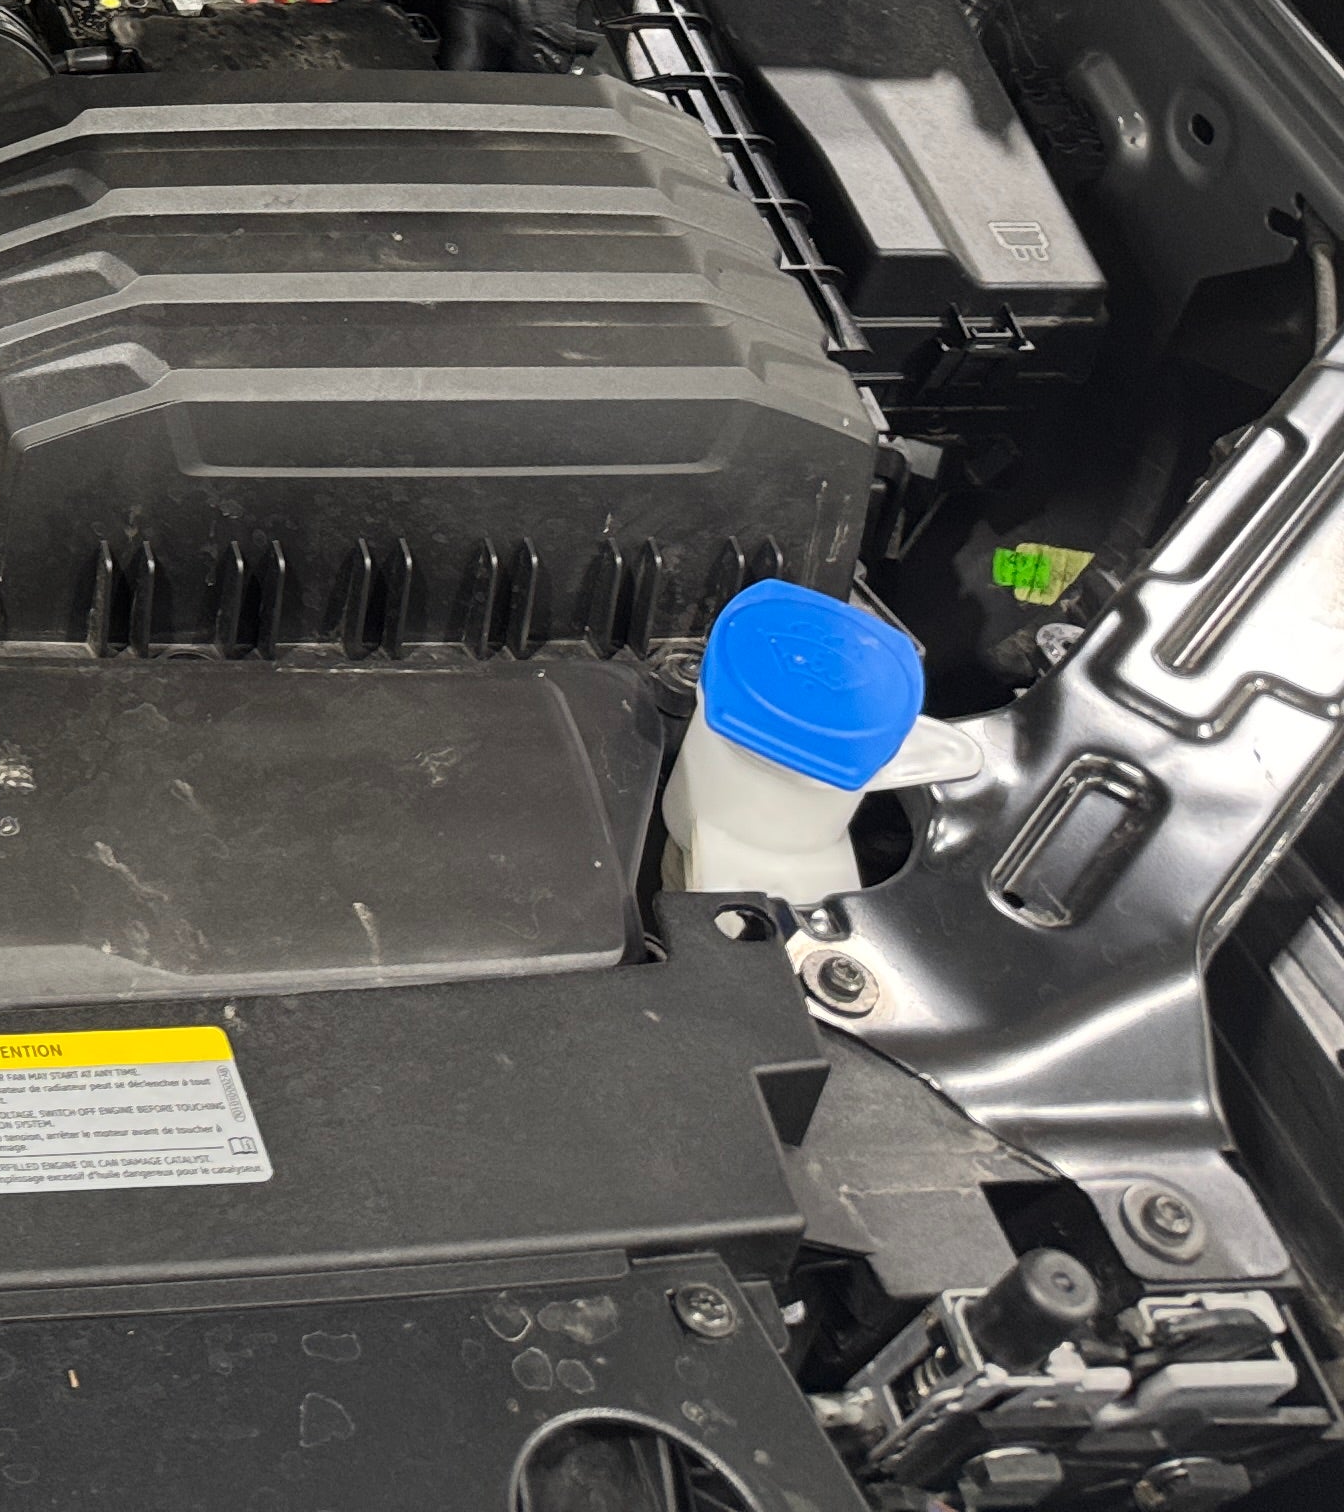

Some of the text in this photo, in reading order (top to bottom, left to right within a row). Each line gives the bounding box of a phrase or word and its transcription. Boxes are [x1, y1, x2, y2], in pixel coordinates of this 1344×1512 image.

[7, 1073, 26, 1081] FAN
[49, 1070, 78, 1080] START
[29, 1084, 40, 1092] de
[38, 1108, 76, 1118] SWITCH
[78, 1107, 96, 1116] OFF
[99, 1105, 134, 1115] ENGINE
[137, 1104, 174, 1113] BEFORE
[176, 1102, 226, 1112] TOUCHING
[162, 1126, 174, 1134] de
[42, 1160, 78, 1170] ENGINE
[98, 1159, 118, 1168] CAN
[121, 1156, 162, 1166] DAMAGE
